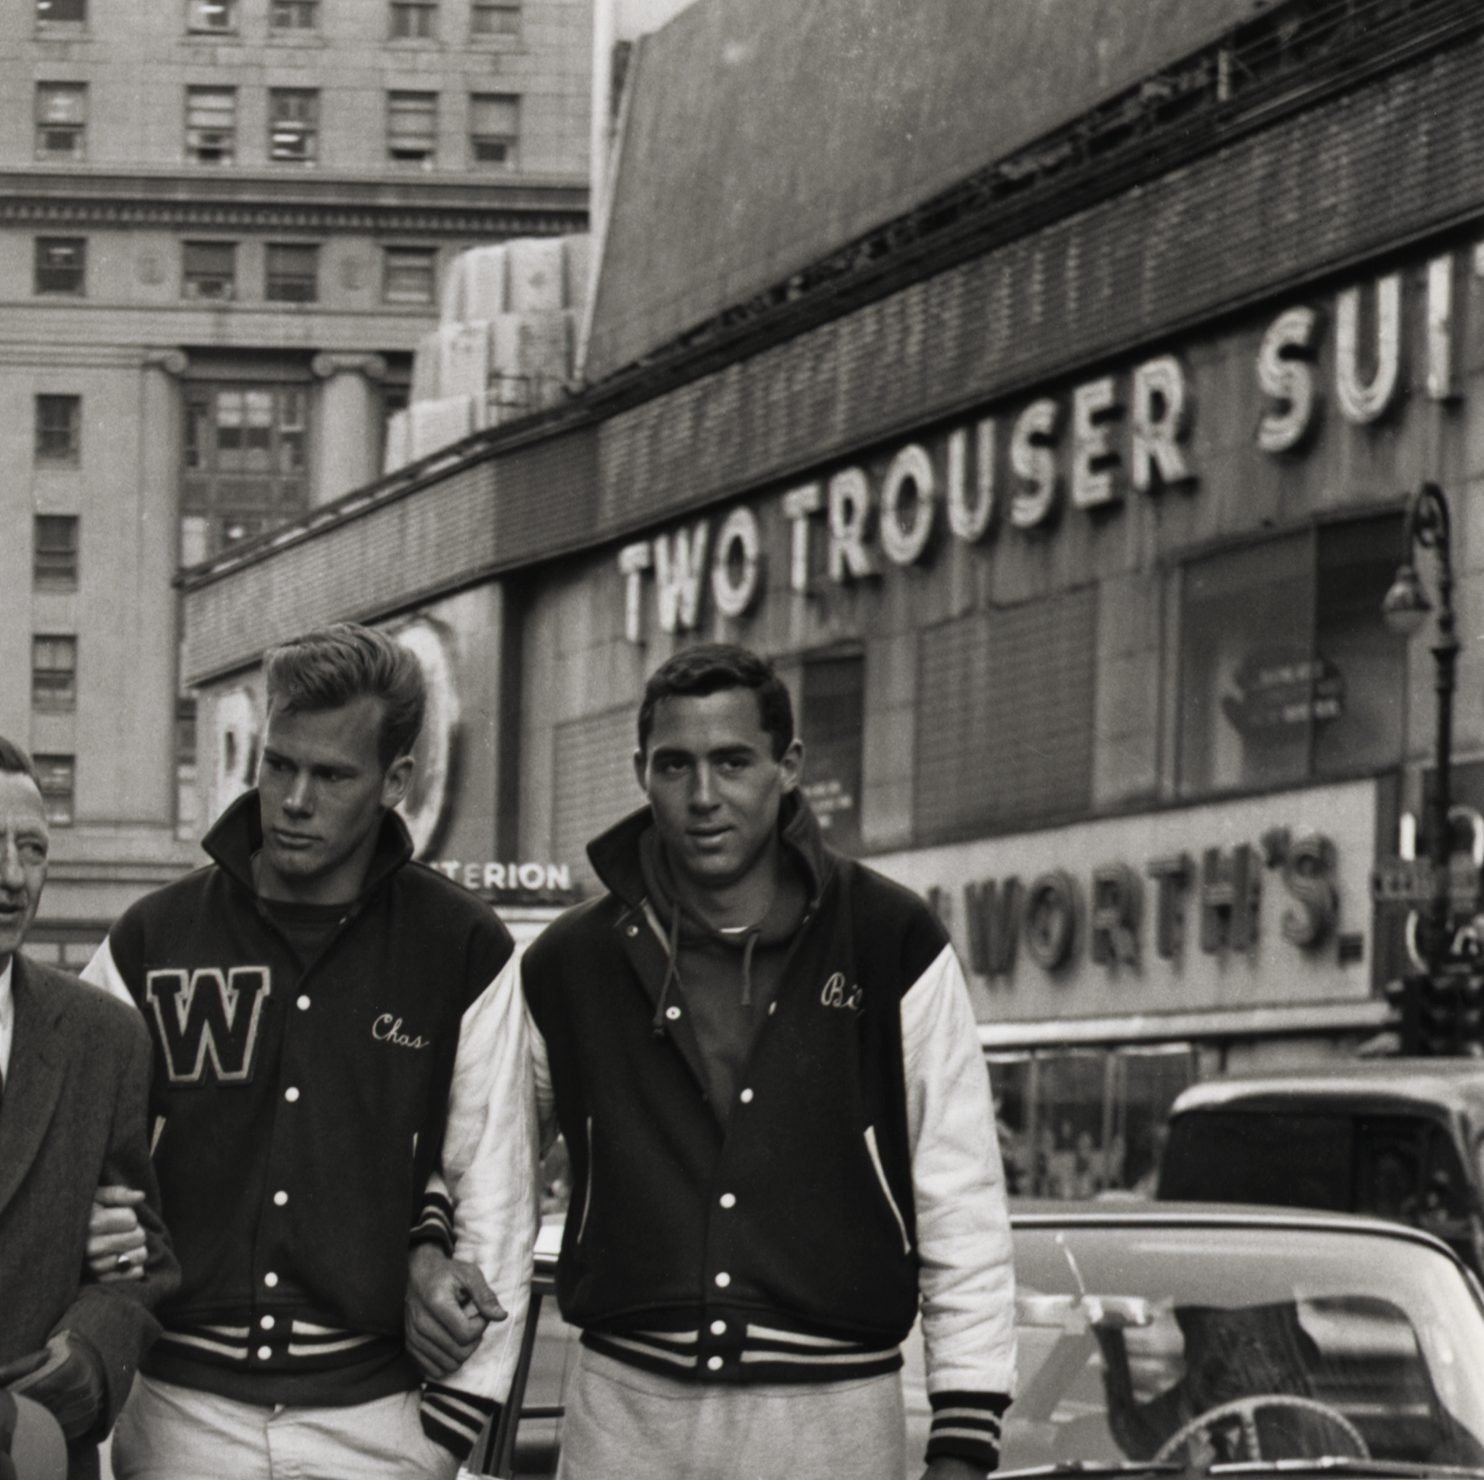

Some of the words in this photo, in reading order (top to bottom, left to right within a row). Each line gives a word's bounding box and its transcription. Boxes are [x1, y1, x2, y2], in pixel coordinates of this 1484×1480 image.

[618, 506, 761, 644] TWO
[783, 353, 1191, 592] TROUSER
[1258, 246, 1484, 453] SUI
[429, 859, 572, 891] TERION
[147, 965, 271, 1083] W
[371, 1012, 430, 1050] Chas
